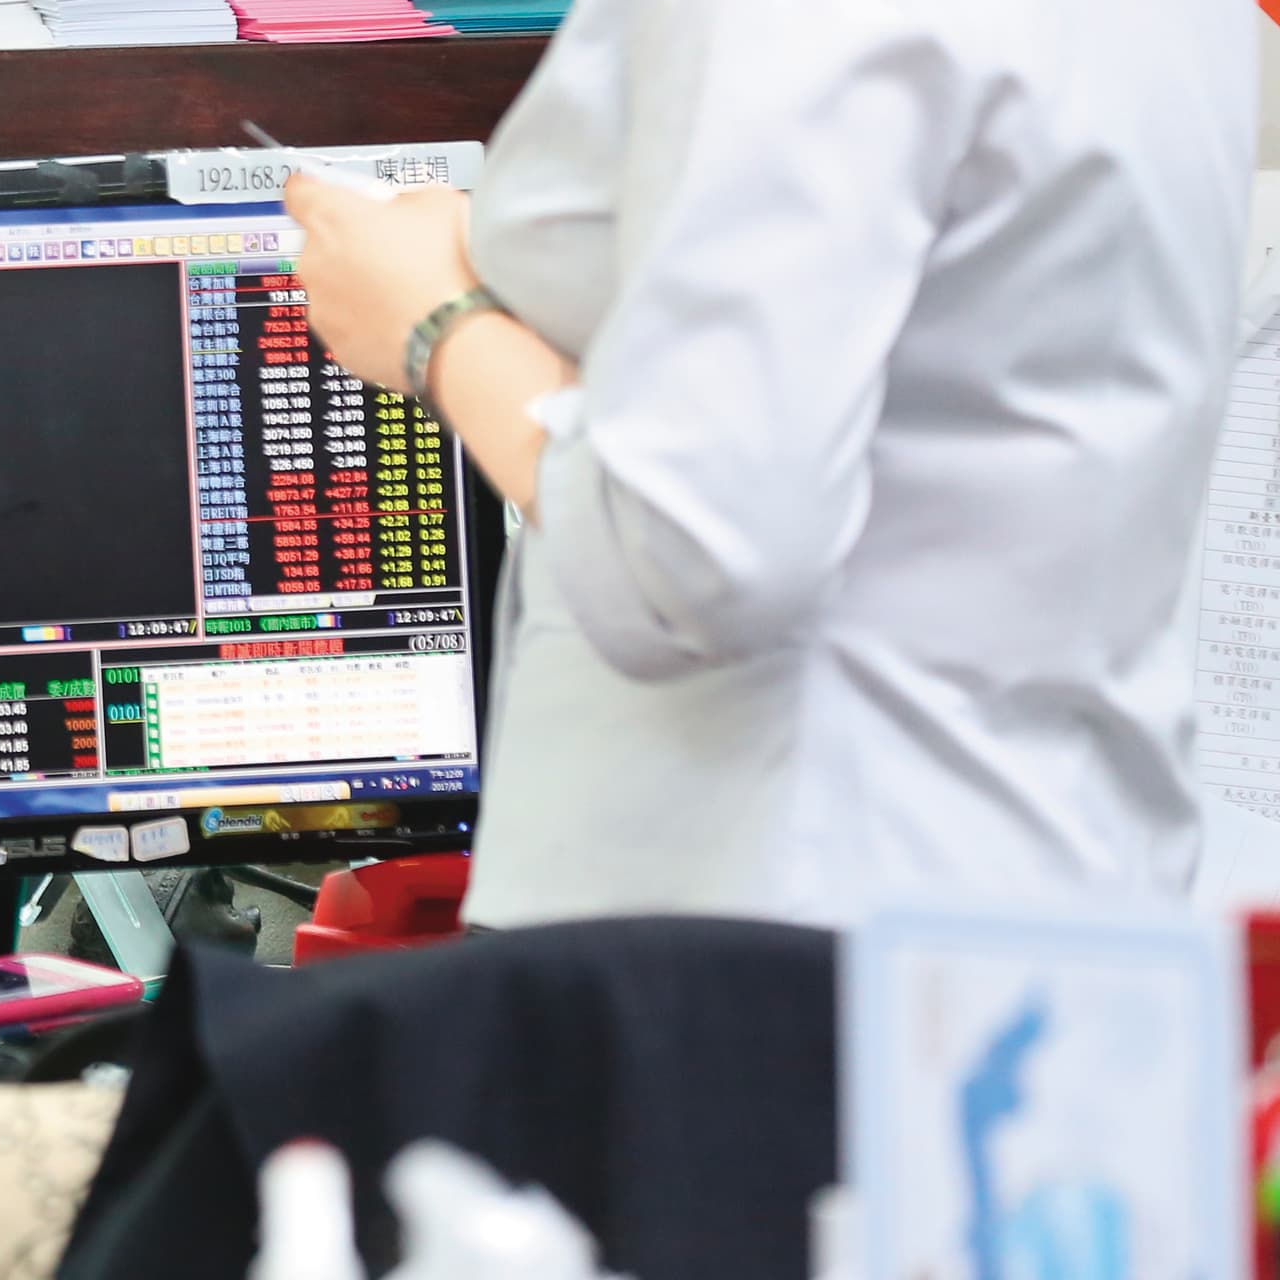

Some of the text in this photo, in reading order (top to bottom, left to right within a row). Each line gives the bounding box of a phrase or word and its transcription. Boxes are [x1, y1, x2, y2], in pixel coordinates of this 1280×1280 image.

[199, 156, 449, 192] 192.168.2 陳佳娟
[395, 609, 456, 625] 12:09:47
[128, 620, 190, 637] 12:09:47
[408, 633, 466, 653] (05/08)
[108, 668, 140, 685] 0101
[110, 705, 144, 721] 0101
[203, 807, 264, 833] Splendid
